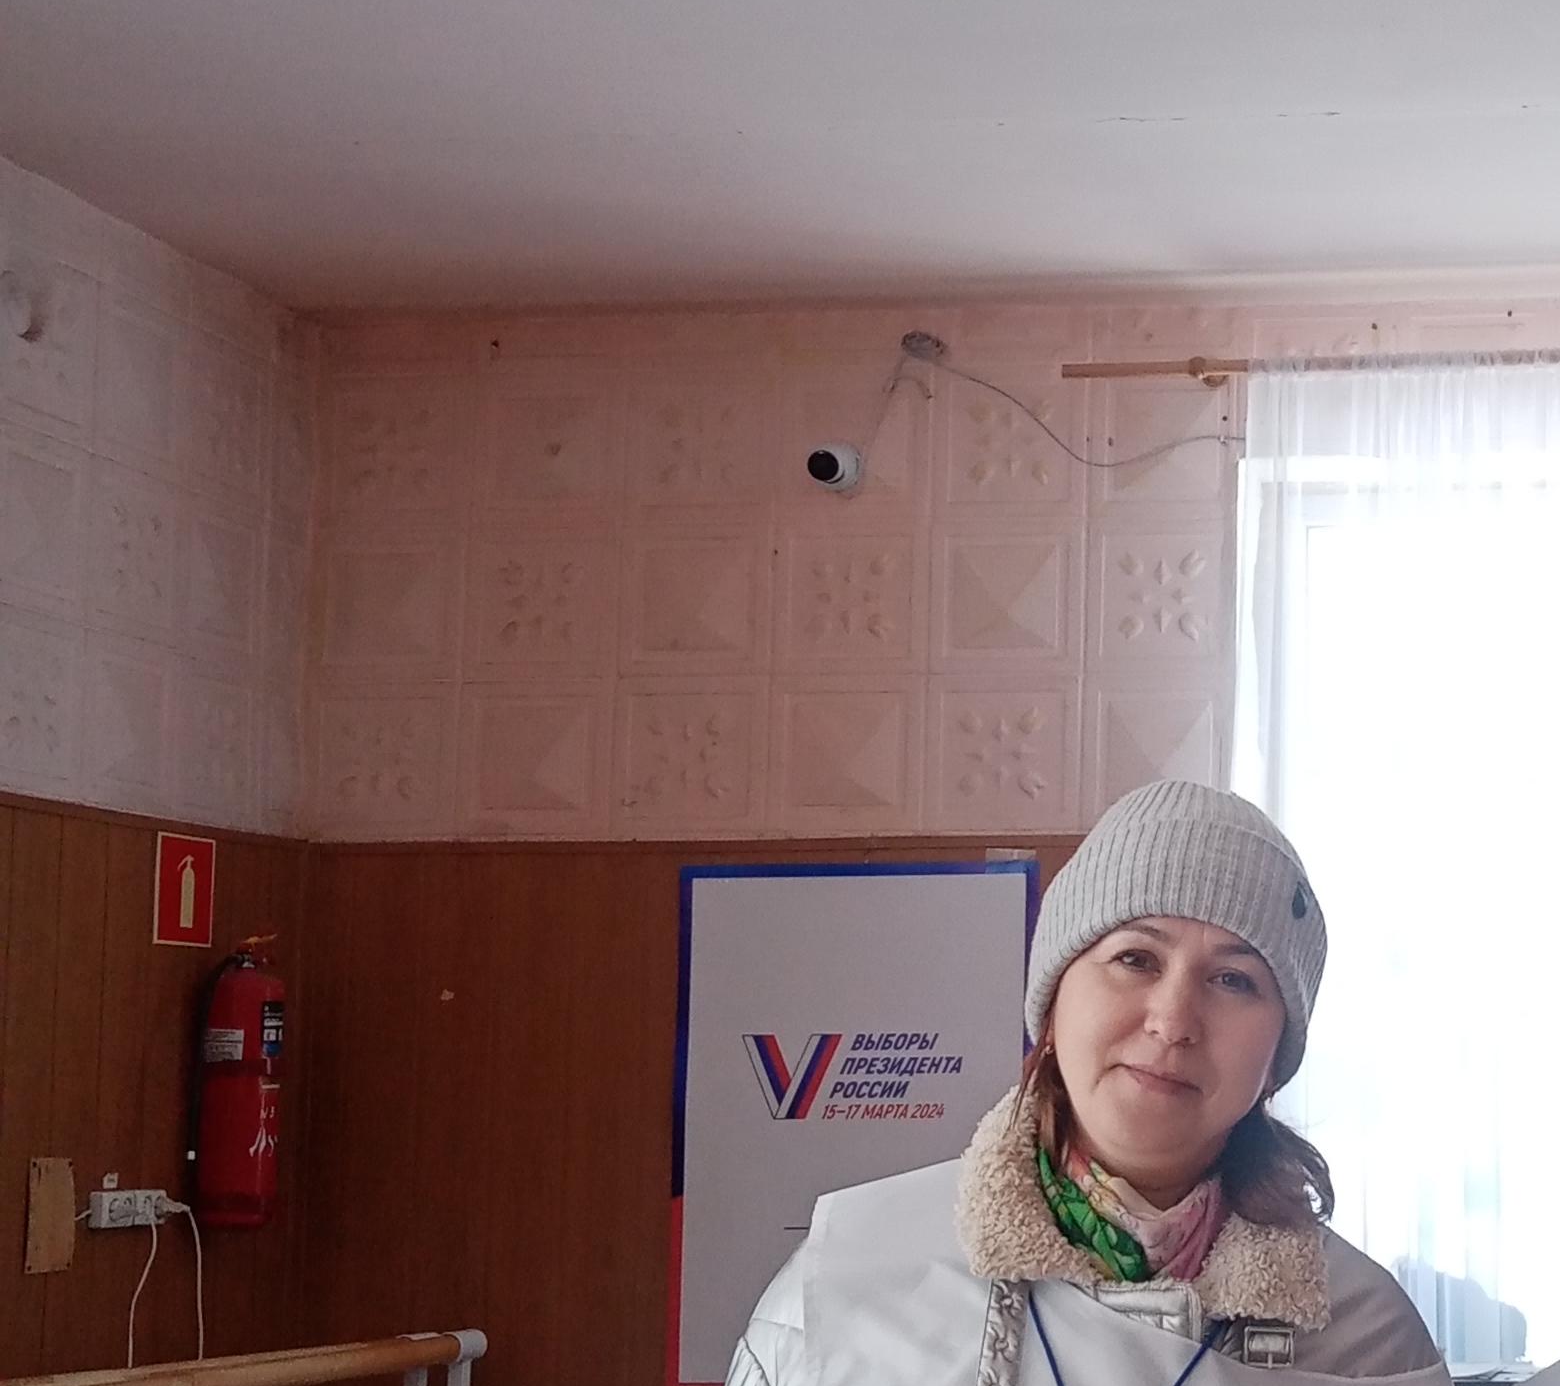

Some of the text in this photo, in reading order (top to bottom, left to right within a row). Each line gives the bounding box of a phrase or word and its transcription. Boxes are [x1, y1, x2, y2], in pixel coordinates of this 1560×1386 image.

[850, 1032, 940, 1051] ВЫБОРЫ
[839, 1056, 963, 1077] ПРЕЗИДЕНТА
[829, 1080, 910, 1099] РОССИИ
[863, 1104, 909, 1120] МАРТА
[909, 1103, 946, 1119] 2024
